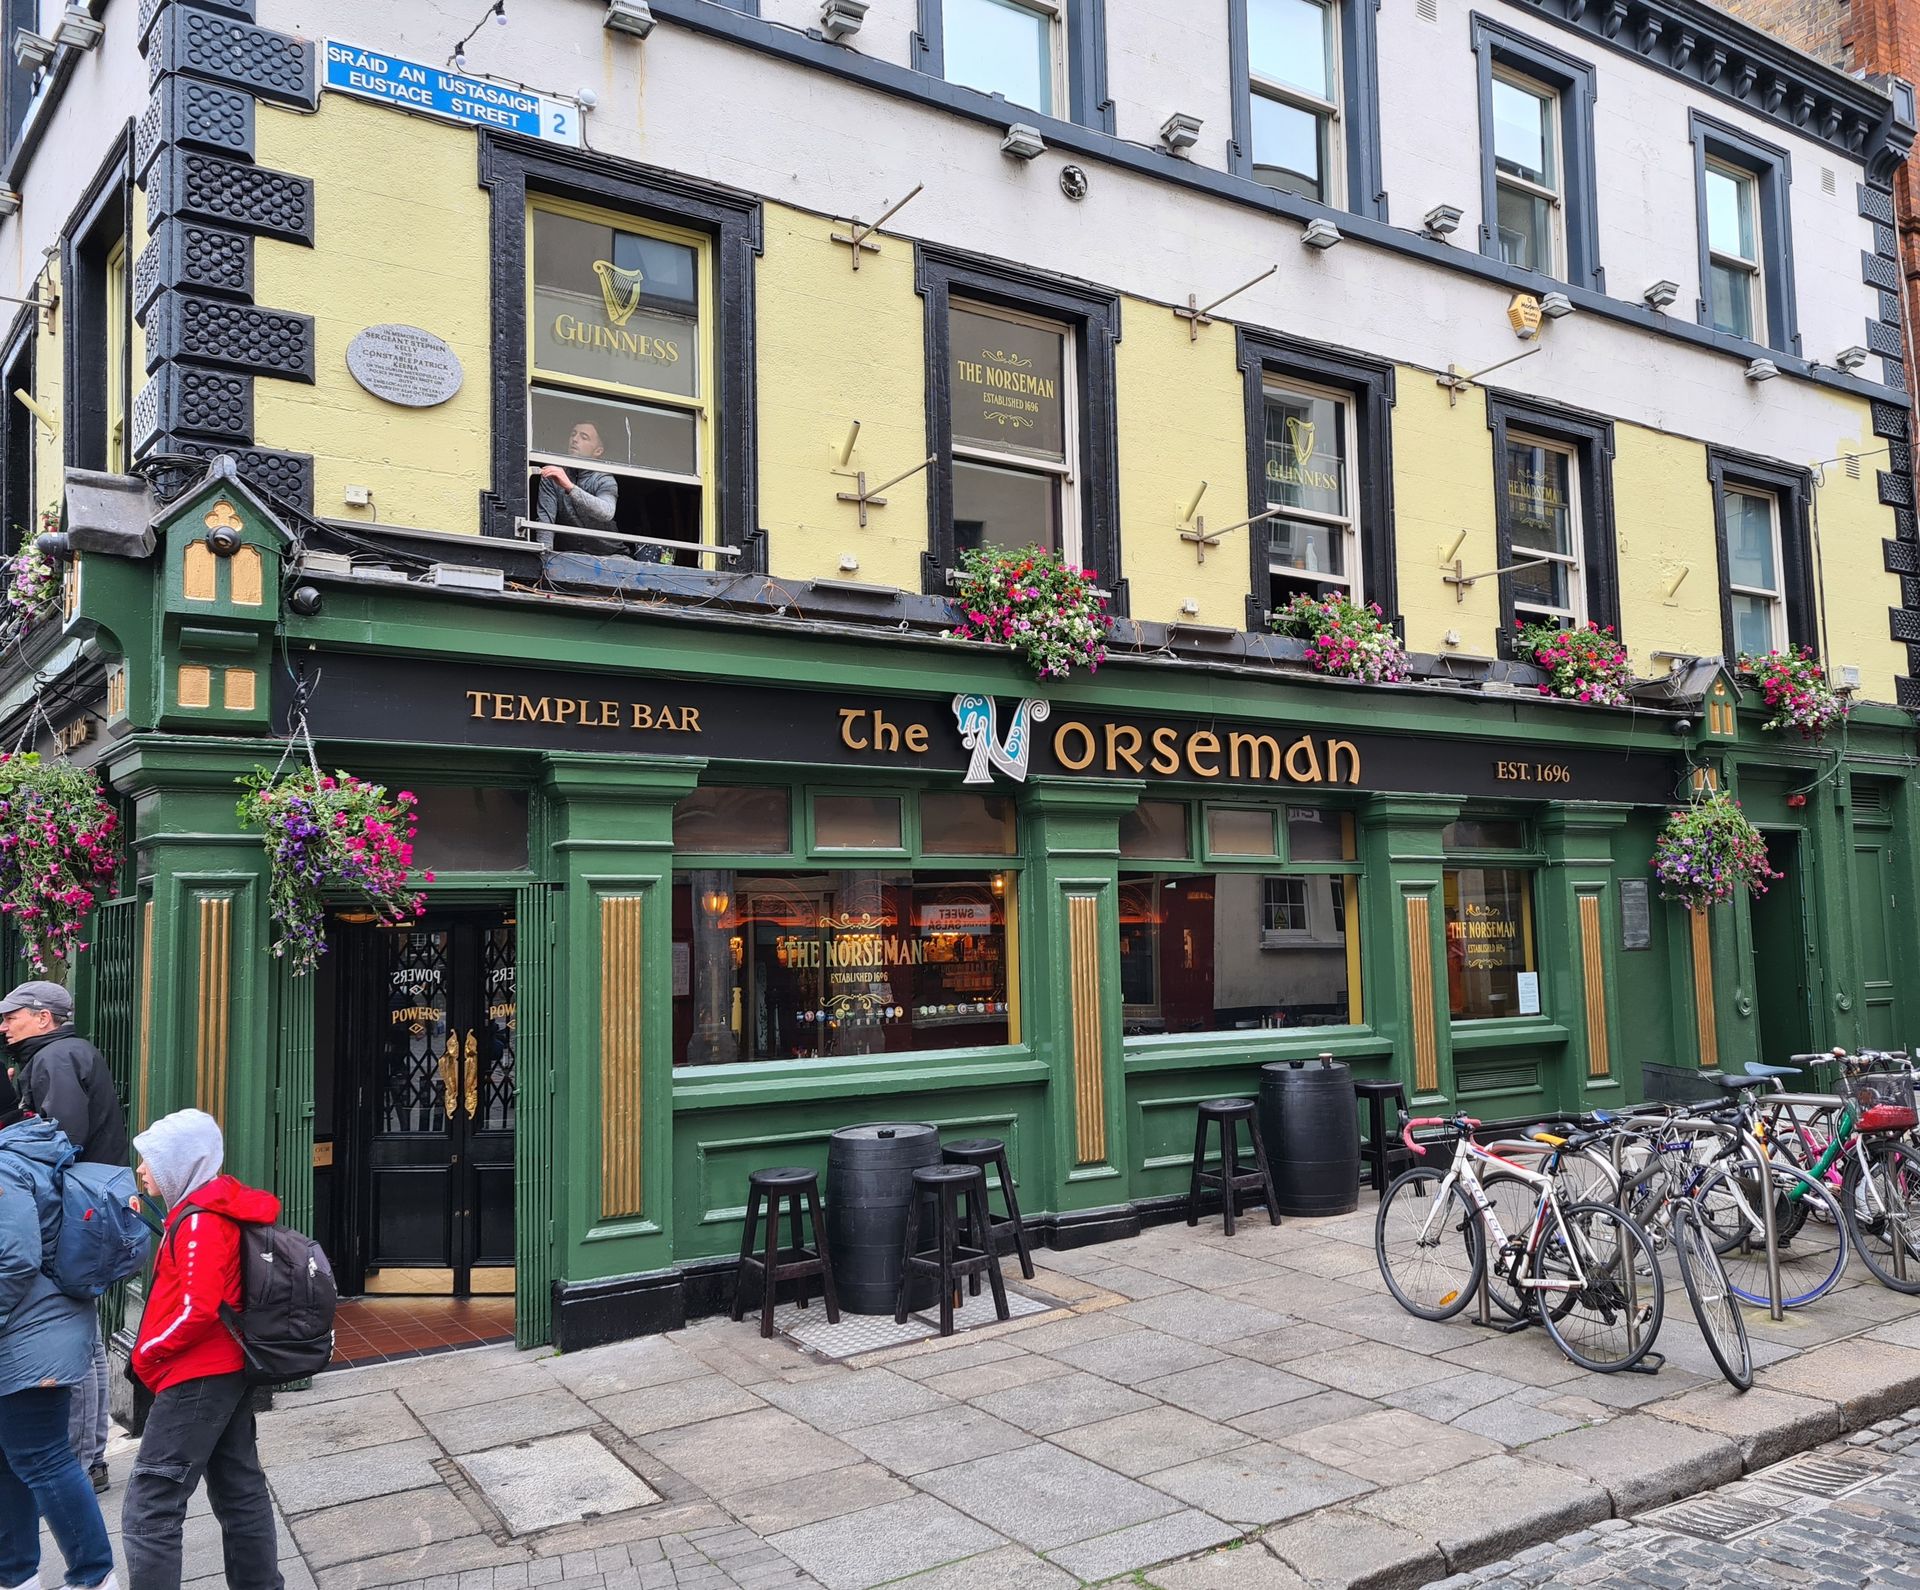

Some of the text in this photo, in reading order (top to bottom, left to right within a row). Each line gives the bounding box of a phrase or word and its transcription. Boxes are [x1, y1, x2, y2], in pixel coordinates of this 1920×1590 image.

[328, 47, 388, 74] SRÁID
[399, 66, 426, 85] AN
[349, 71, 520, 127] EUSTACE STREET
[552, 113, 567, 135] 2
[365, 331, 446, 353] SERGEANT STEPHEN
[394, 344, 418, 353] KELLY
[555, 313, 679, 362] GUINNESS
[362, 349, 448, 371] CONSTABLE PATRICK
[393, 361, 418, 372] KEENA
[958, 360, 1055, 398] THE NORSEMAN
[983, 392, 1039, 412] ESTABLISHED 1696
[1266, 459, 1338, 491] GUINNESS
[466, 690, 703, 732] TEMPLE BAR
[1497, 761, 1571, 782] EST. 1696
[1450, 921, 1516, 938] THE NORSEMAN
[784, 939, 923, 968] THE NORSEMAN
[831, 972, 873, 983] ESTABLISHED
[392, 1006, 441, 1025] POWERS
